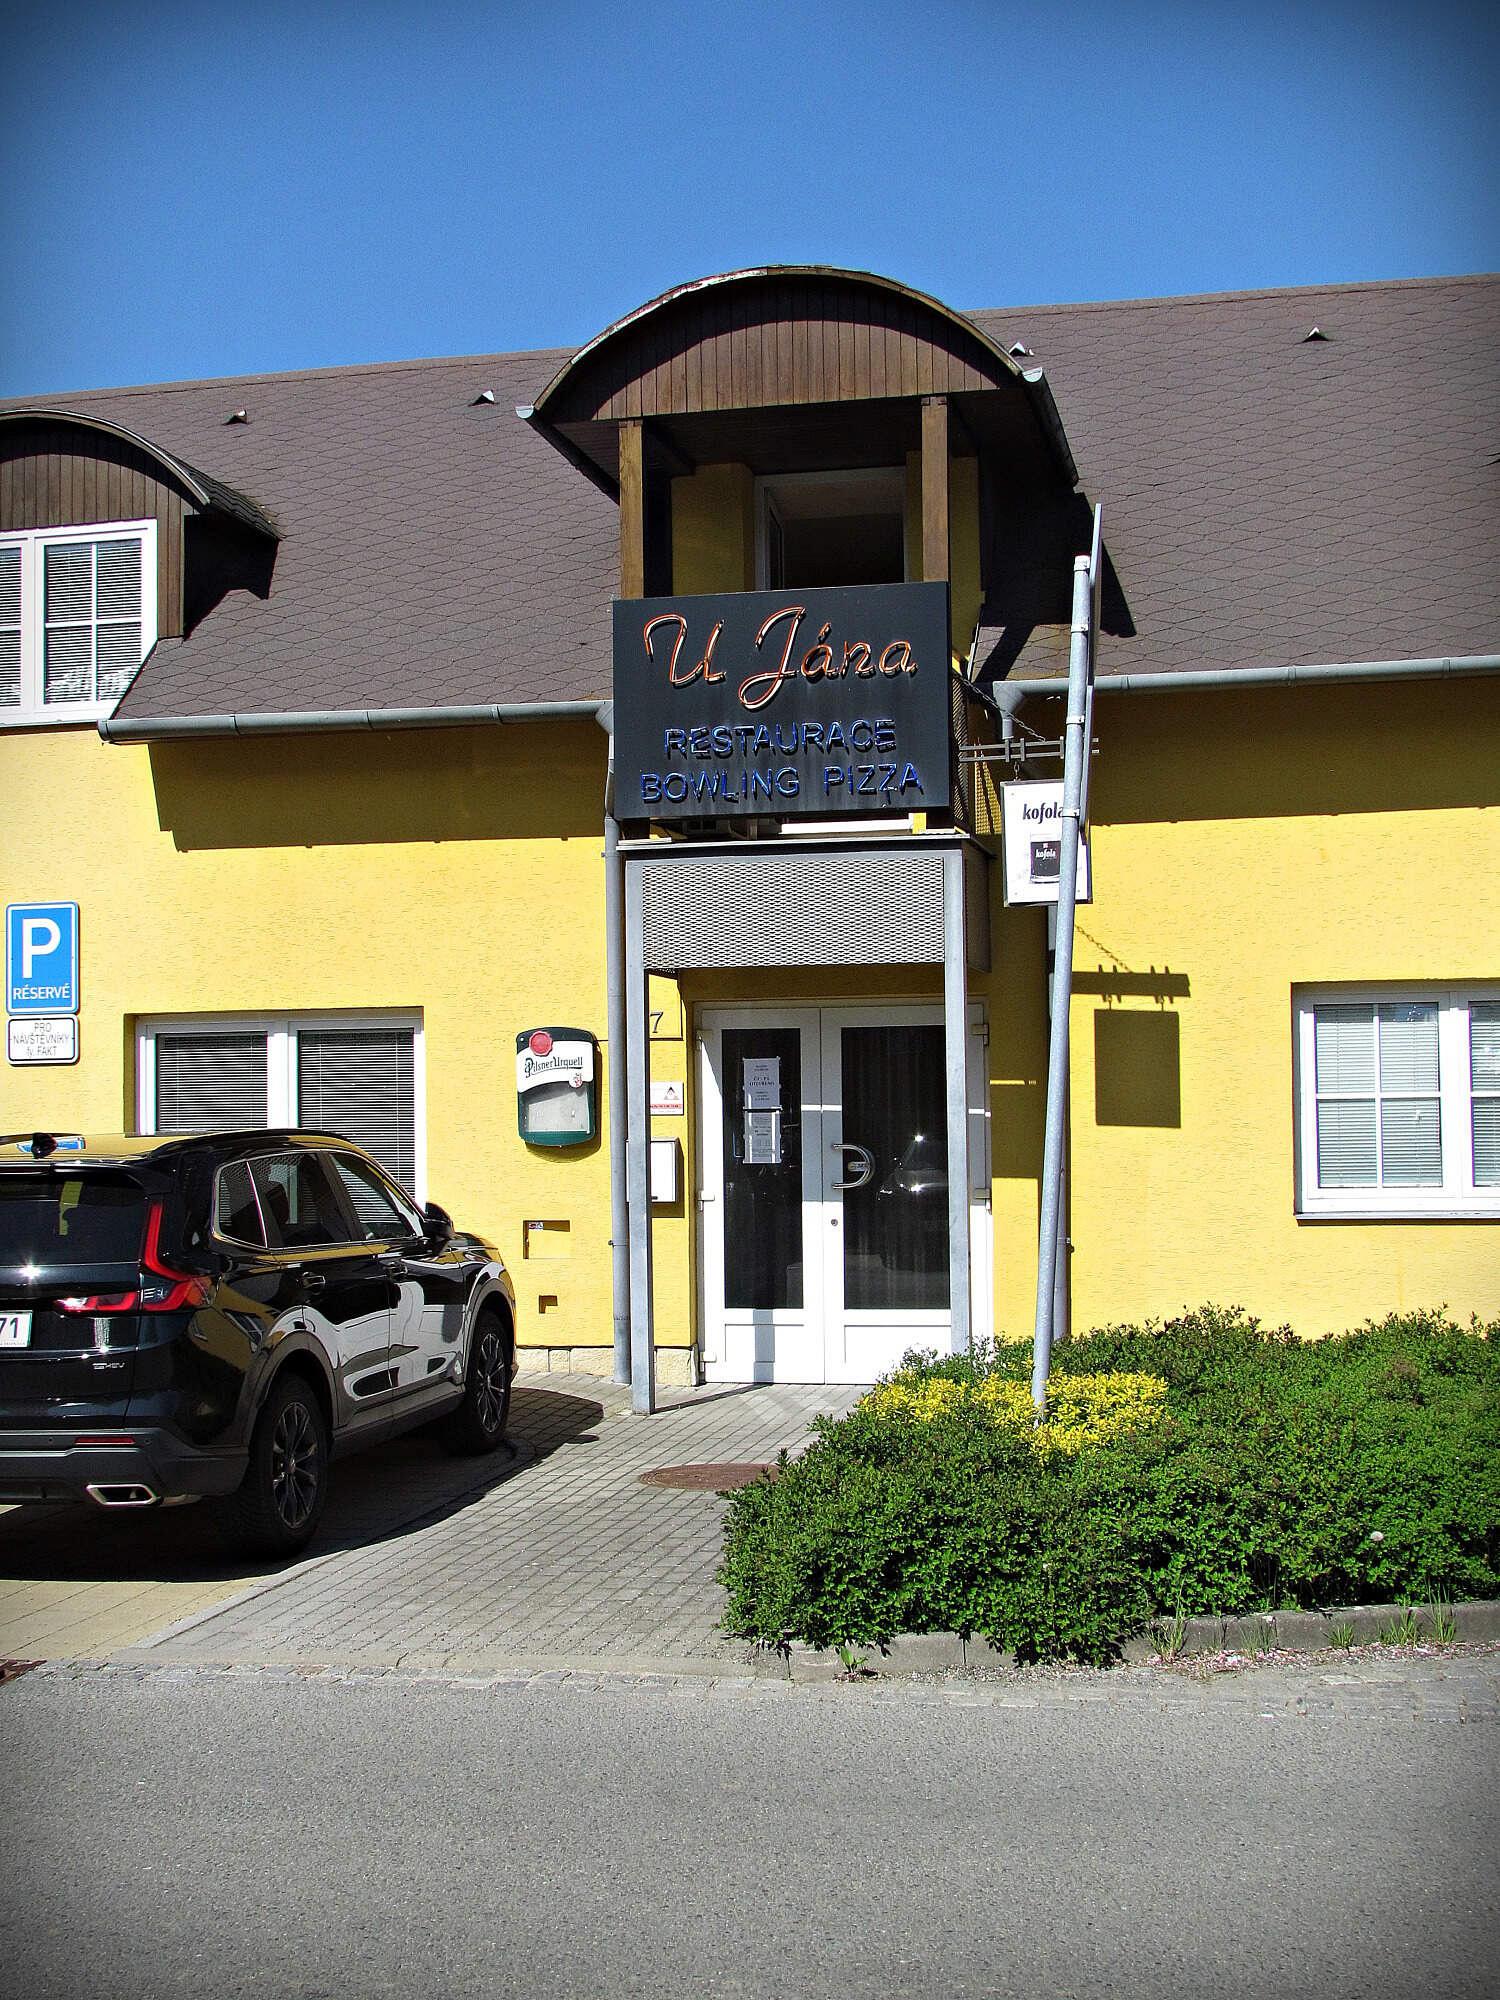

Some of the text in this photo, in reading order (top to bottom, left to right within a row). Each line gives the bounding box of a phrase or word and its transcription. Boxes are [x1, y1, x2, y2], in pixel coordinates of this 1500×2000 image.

[643, 606, 919, 710] U Jána
[664, 718, 898, 756] RESTAURACE
[640, 762, 924, 802] BOWLING PIZZA
[22, 917, 61, 979] P
[13, 983, 71, 1000] RÉSERVÉ
[34, 1022, 52, 1033] PRO
[525, 1055, 584, 1079] Pilsner Urquell
